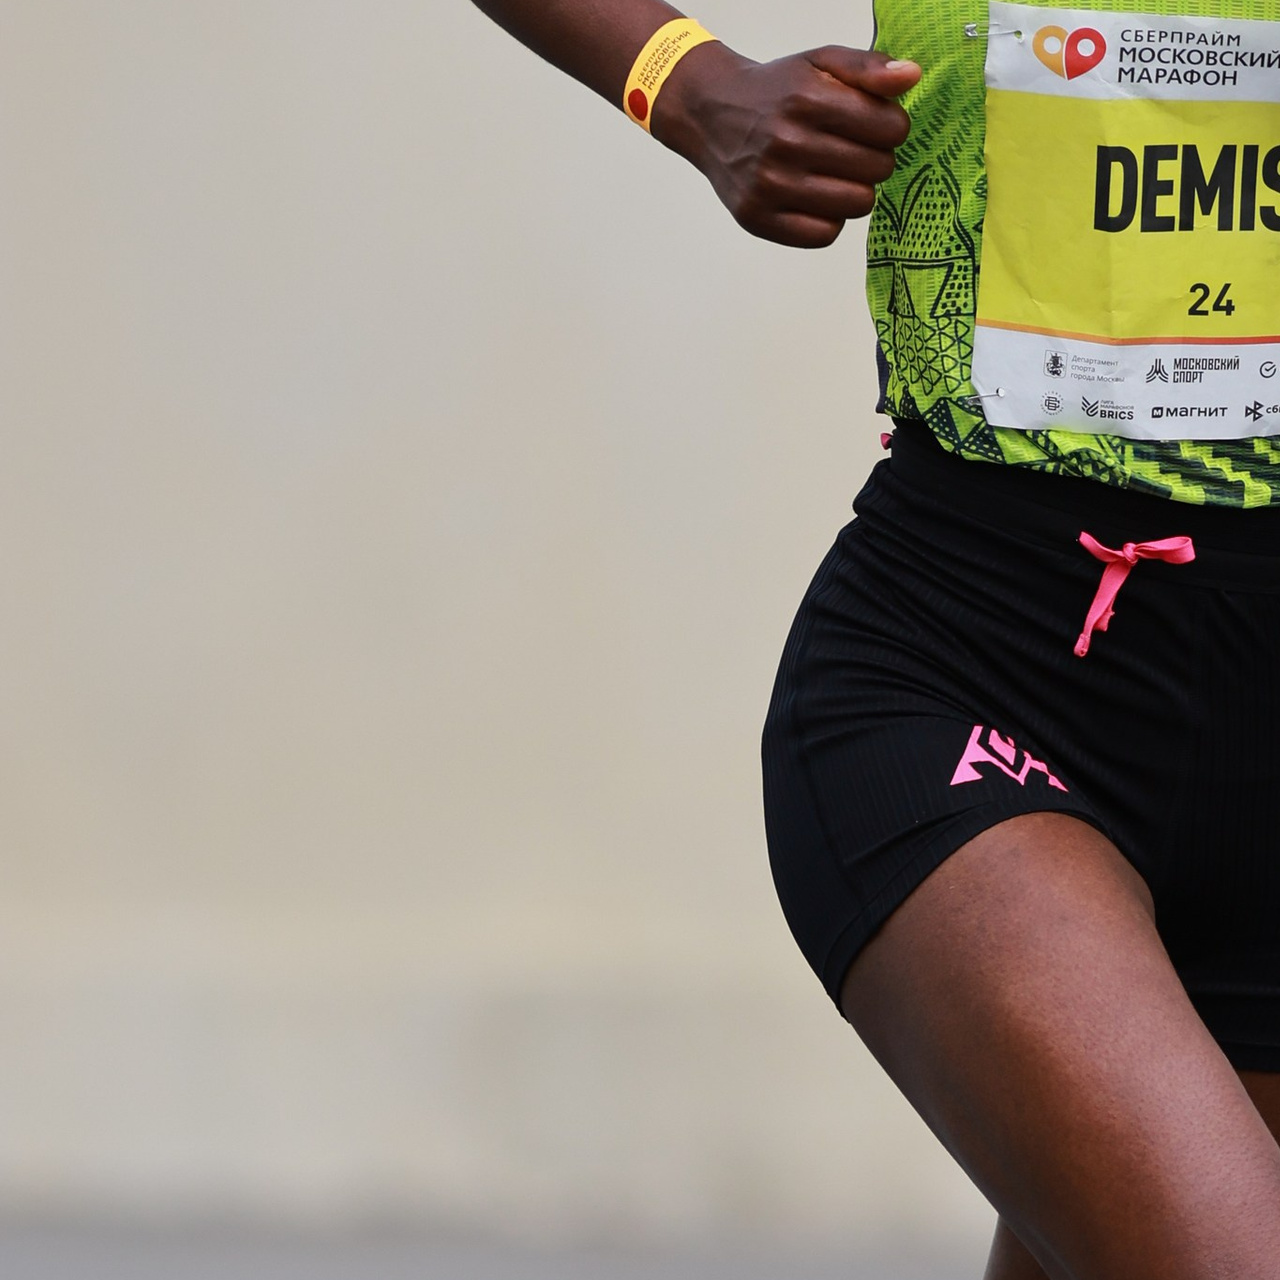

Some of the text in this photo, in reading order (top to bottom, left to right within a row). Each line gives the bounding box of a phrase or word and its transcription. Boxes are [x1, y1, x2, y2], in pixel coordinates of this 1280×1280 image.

[1120, 29, 1241, 47] СБЕРПРАЙМ
[641, 30, 691, 87] МОСКОВСКИЙ
[648, 45, 682, 91] МАРАФОН
[1117, 67, 1238, 86] МАРАФОН
[1188, 283, 1235, 316] 24
[1071, 355, 1119, 366] Департамент
[1173, 356, 1240, 371] МОСКОВСКИЙ
[1071, 365, 1096, 373] спорта
[1070, 373, 1095, 382] города
[1173, 371, 1204, 383] СПОРТ
[1100, 410, 1134, 420] BRICS
[1166, 407, 1228, 417] магнит
